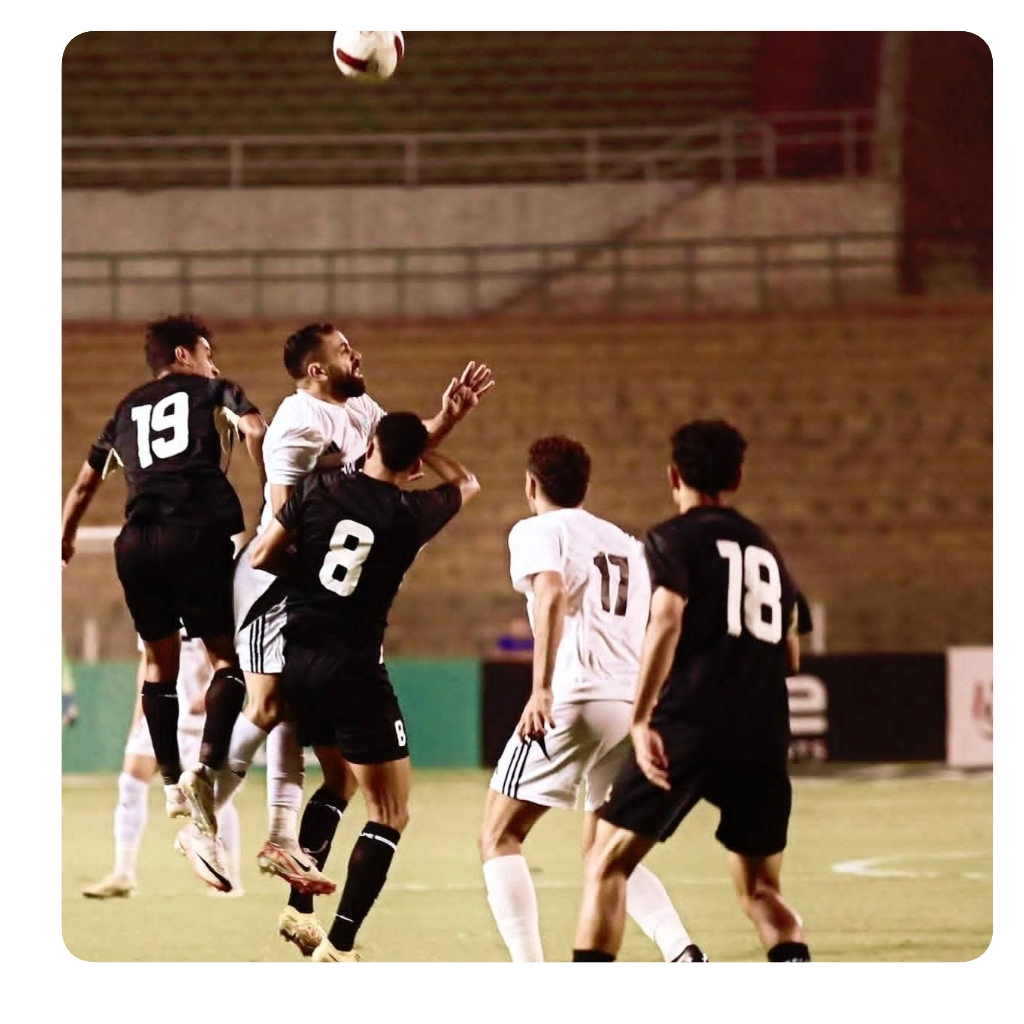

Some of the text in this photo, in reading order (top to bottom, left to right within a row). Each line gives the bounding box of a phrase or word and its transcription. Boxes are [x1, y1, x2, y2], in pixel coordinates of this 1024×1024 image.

[131, 391, 189, 469] 19
[319, 519, 375, 597] 8
[593, 551, 630, 617] 17
[716, 539, 782, 645] 18
[394, 719, 407, 747] 8
